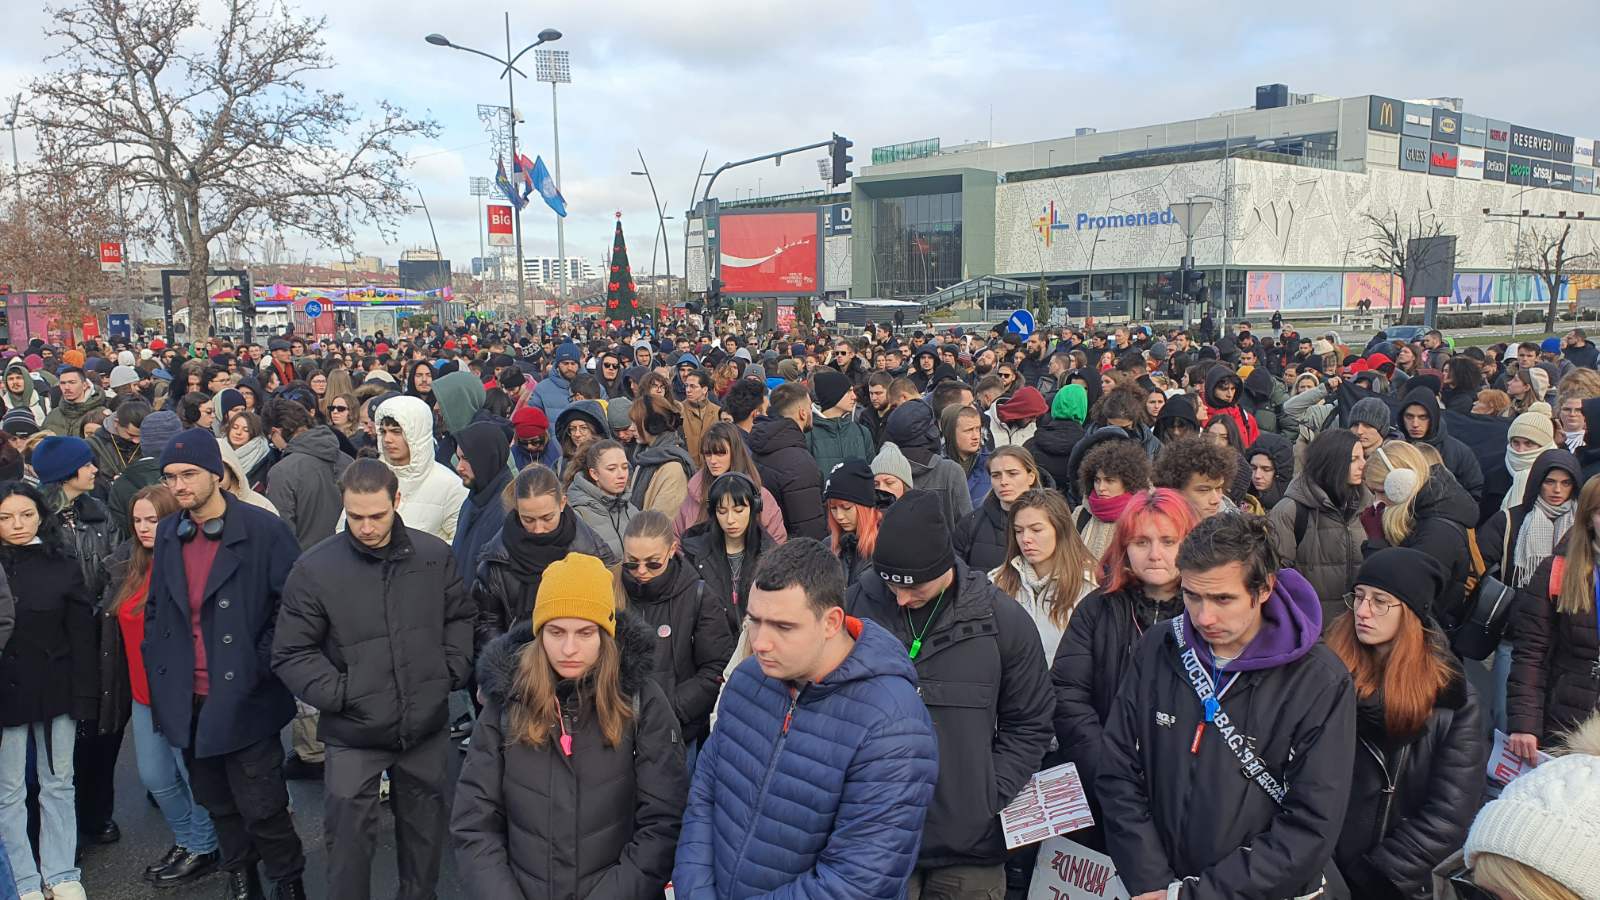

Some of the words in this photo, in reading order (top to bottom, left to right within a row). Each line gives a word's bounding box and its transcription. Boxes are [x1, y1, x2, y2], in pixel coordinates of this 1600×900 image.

[1513, 132, 1552, 152] RESERVED
[1406, 147, 1427, 163] GUESS
[880, 571, 914, 584] OCB
